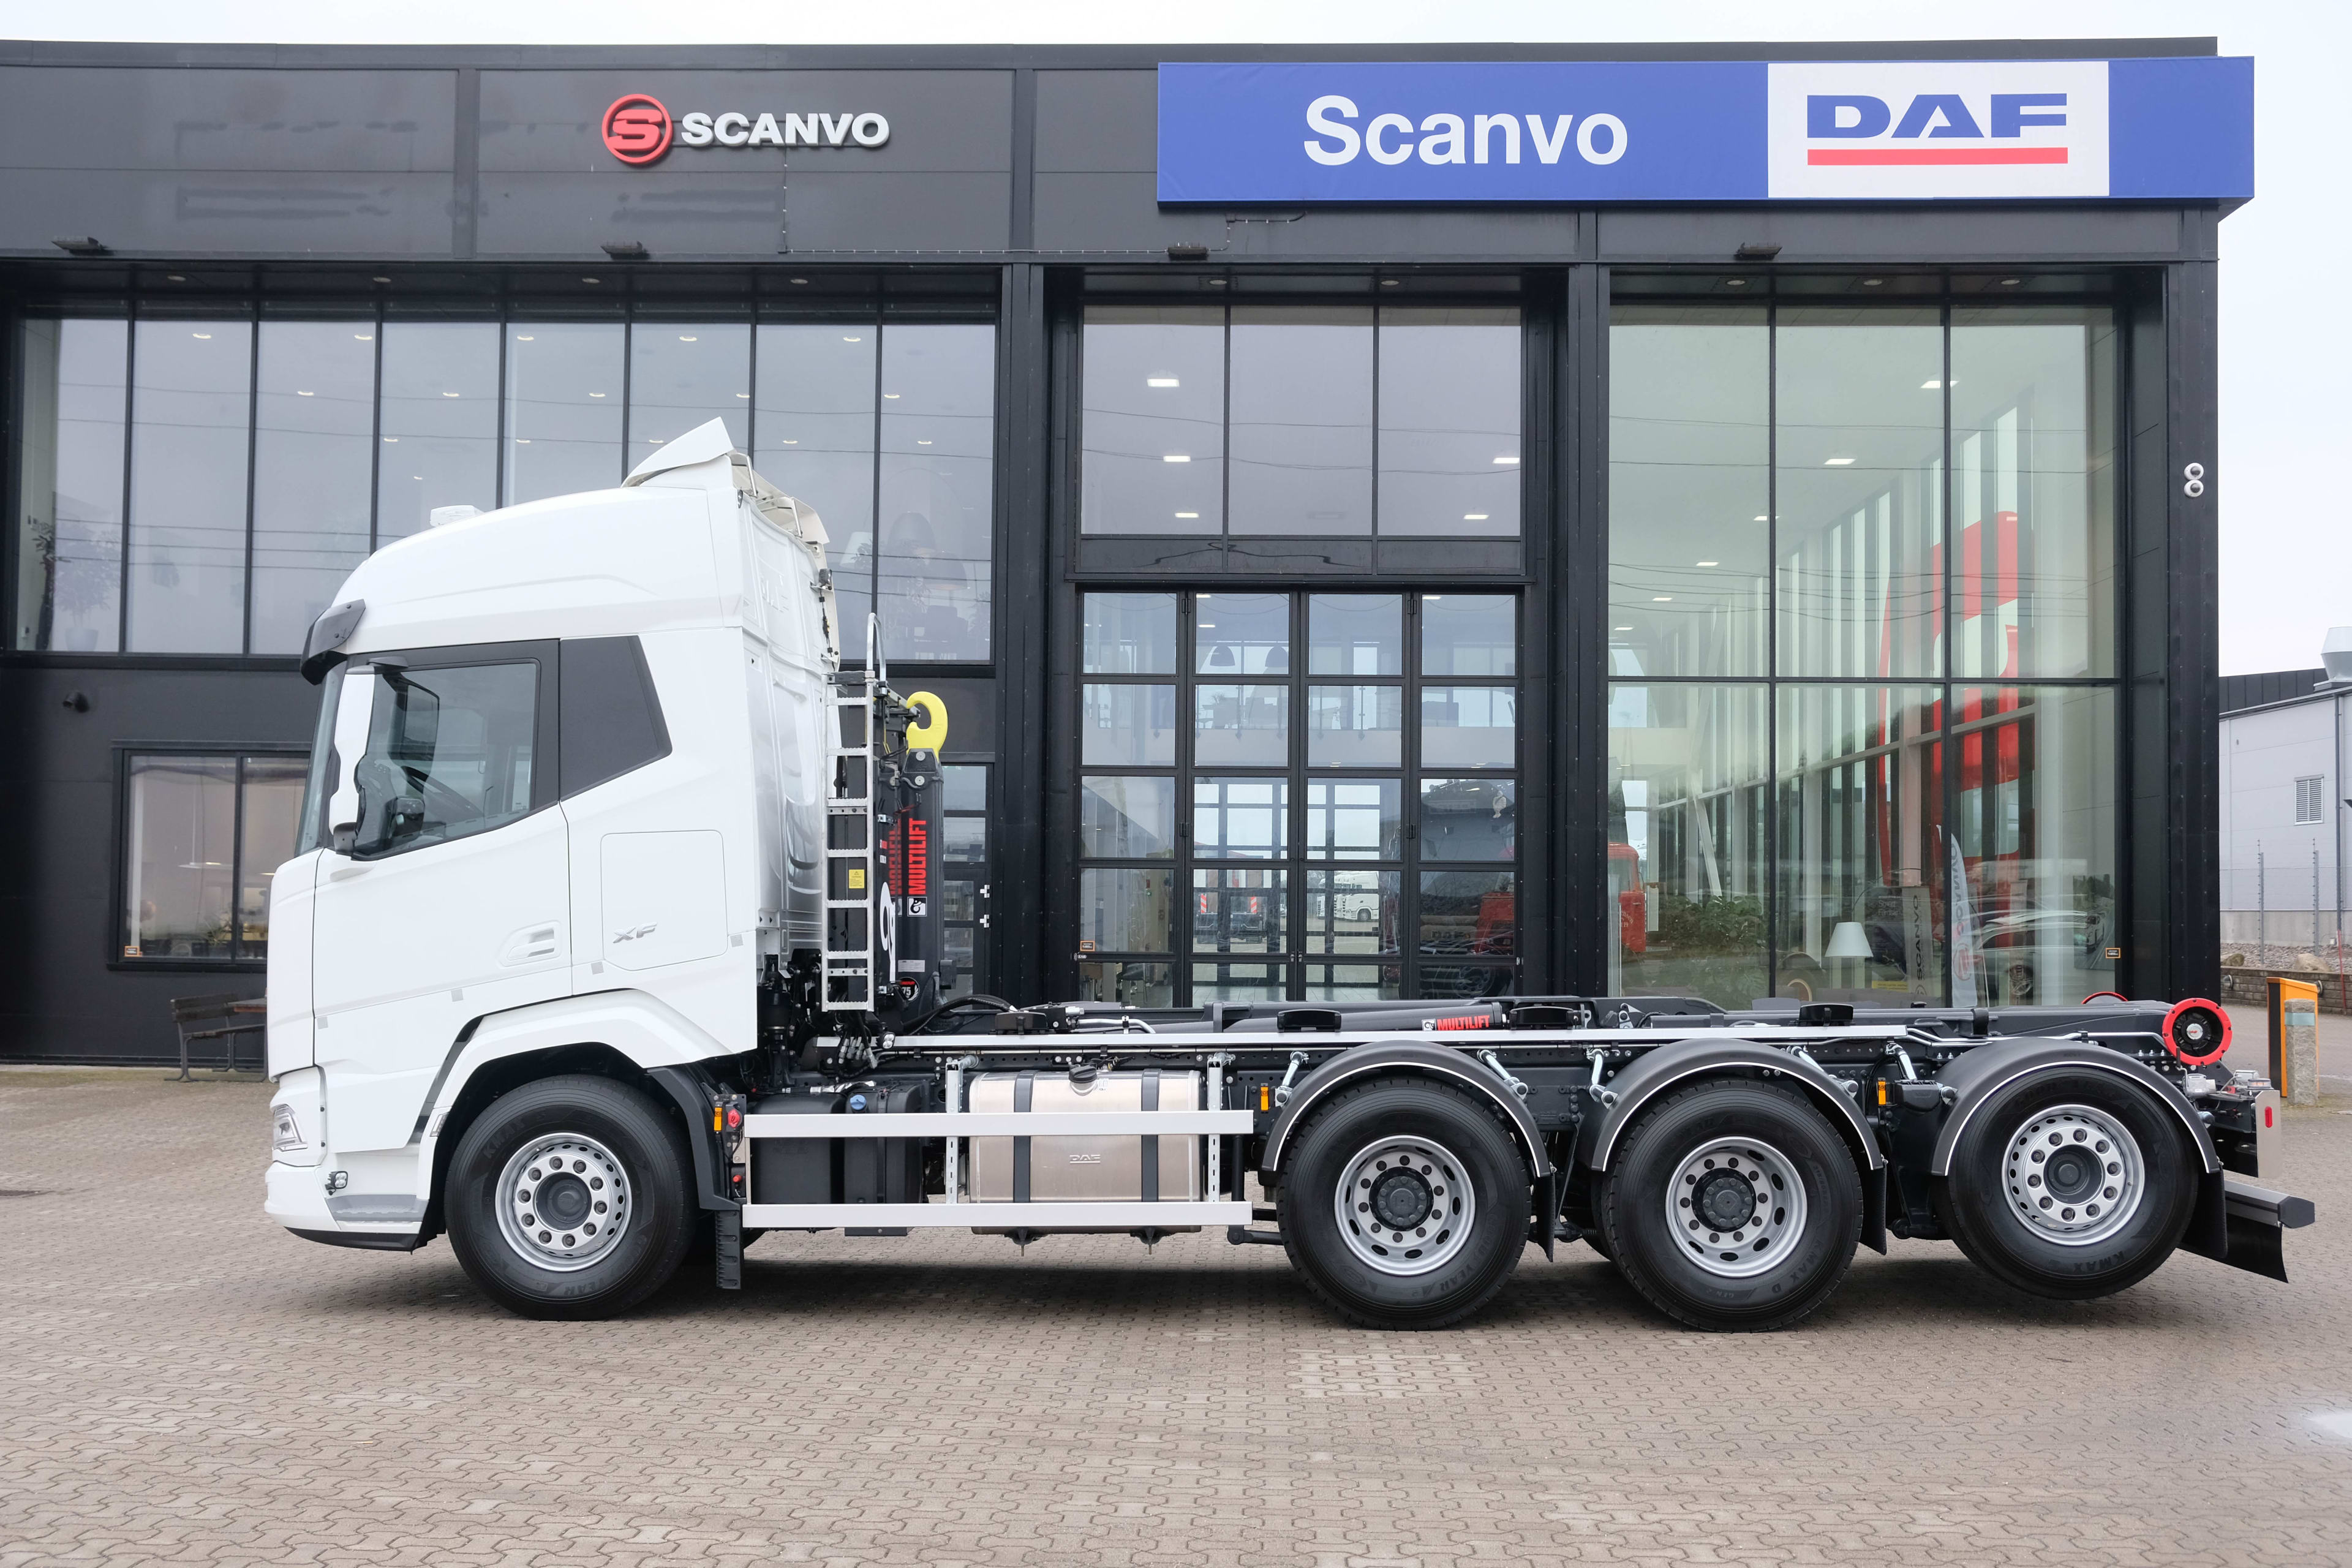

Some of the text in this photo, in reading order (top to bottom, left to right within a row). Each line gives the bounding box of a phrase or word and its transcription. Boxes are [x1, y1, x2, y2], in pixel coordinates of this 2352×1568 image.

[681, 112, 890, 148] SCANVO
[1304, 94, 1629, 166] Scanvo
[1807, 93, 2068, 139] DAF
[908, 818, 927, 895] MULTILIFT
[612, 921, 657, 944] XF
[1913, 894, 1923, 981] SCANVO
[1436, 1015, 1490, 1031] MULTILIFT
[1789, 1237, 1826, 1285] KMAX
[2071, 1250, 2128, 1273] KMAX
